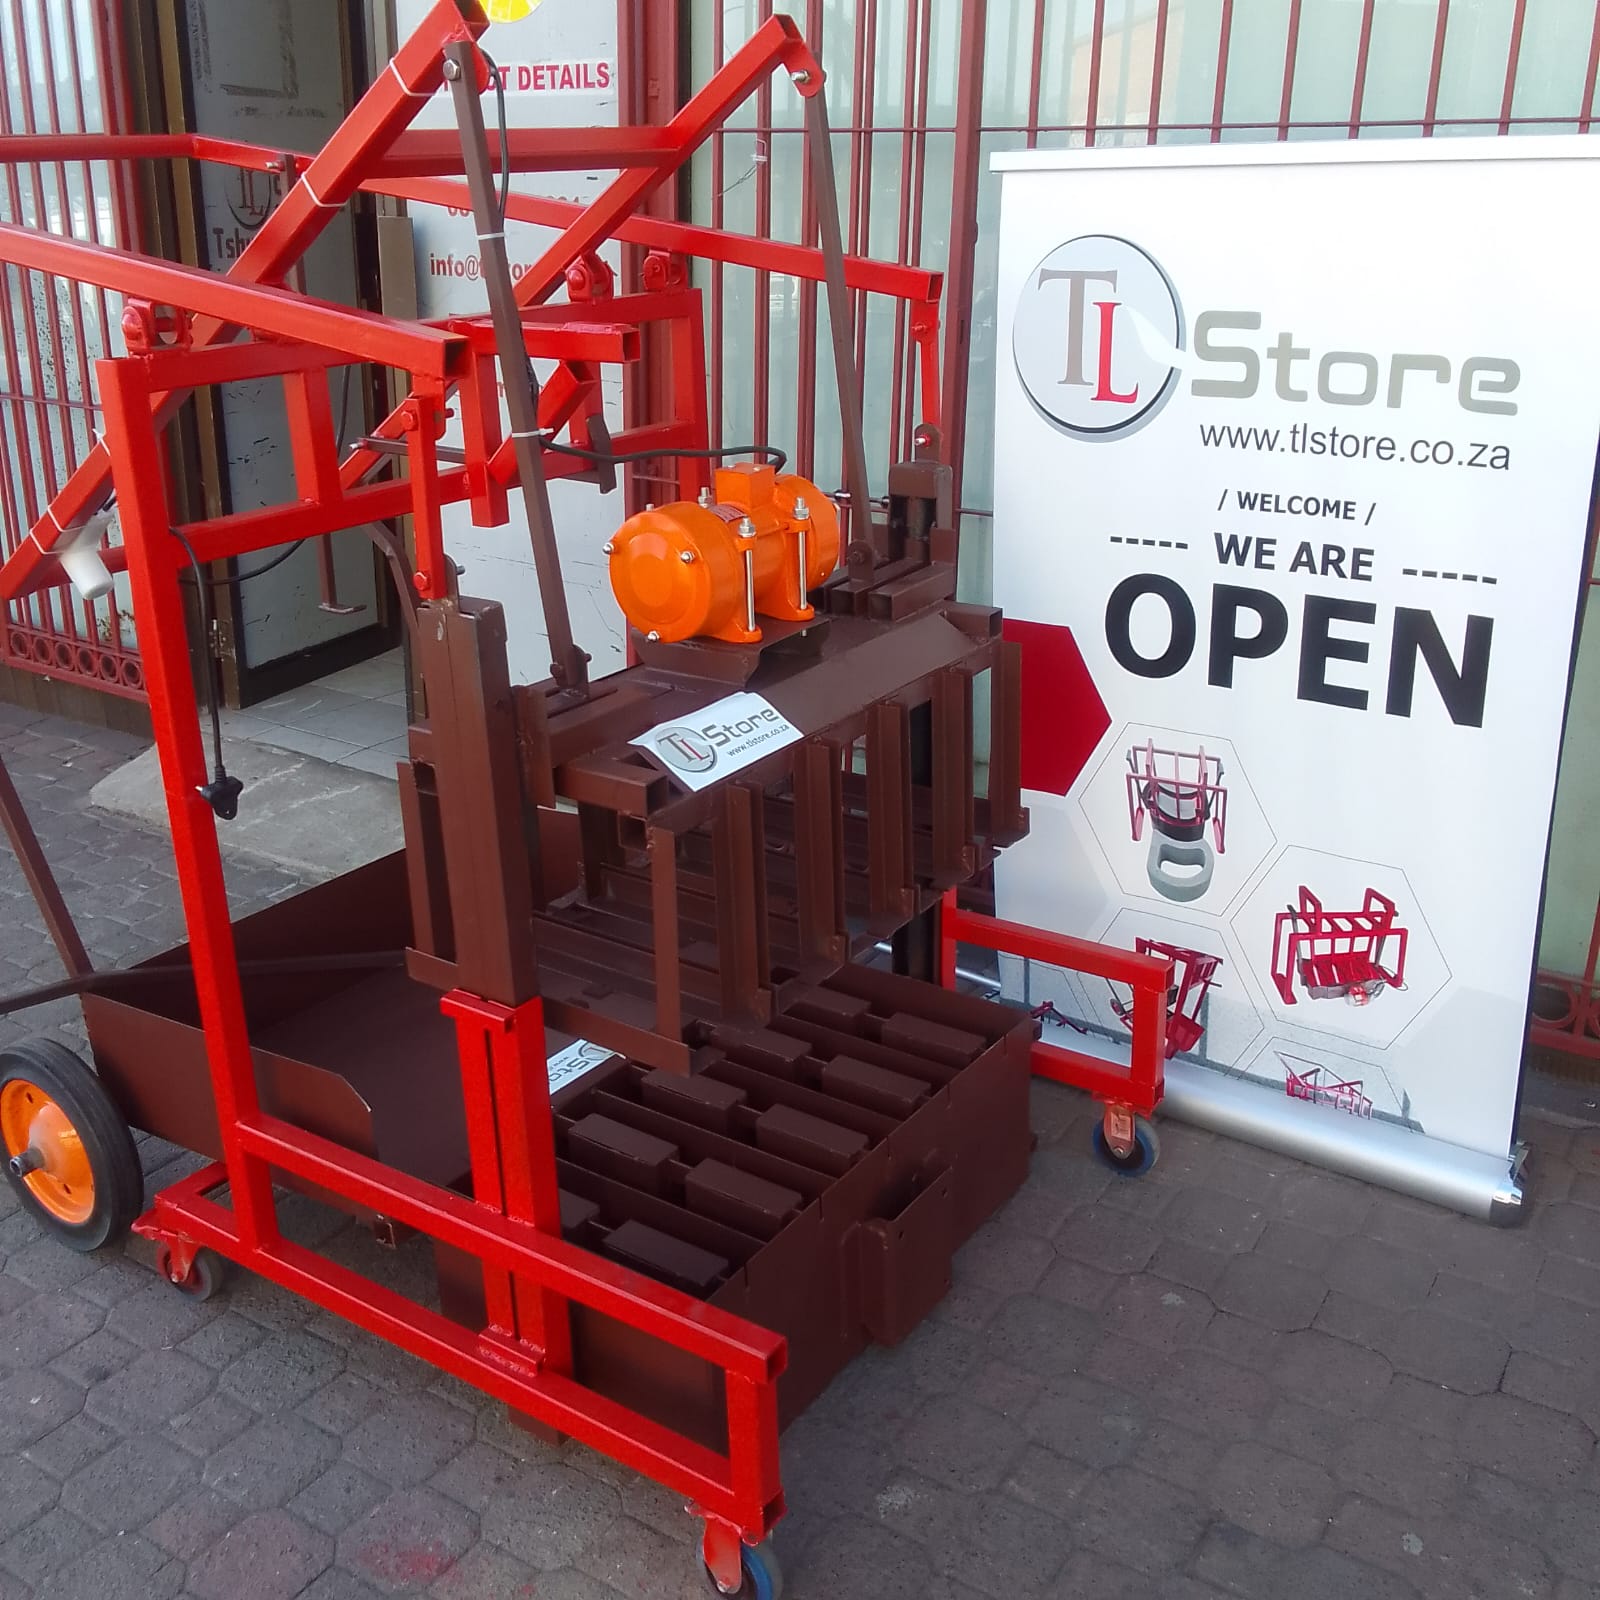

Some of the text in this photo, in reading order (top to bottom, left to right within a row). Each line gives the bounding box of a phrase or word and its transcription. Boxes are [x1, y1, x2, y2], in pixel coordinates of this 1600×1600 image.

[518, 62, 610, 91] DETAILS
[212, 227, 257, 259] Tsh
[1038, 268, 1521, 416] TL Store
[1199, 422, 1512, 471] www.tlstore.co.za
[1237, 490, 1357, 521] WELCOME
[1213, 532, 1375, 582] WE ARE
[1105, 573, 1495, 729] OPEN
[702, 708, 779, 747] Store
[549, 1058, 590, 1082] Sto
